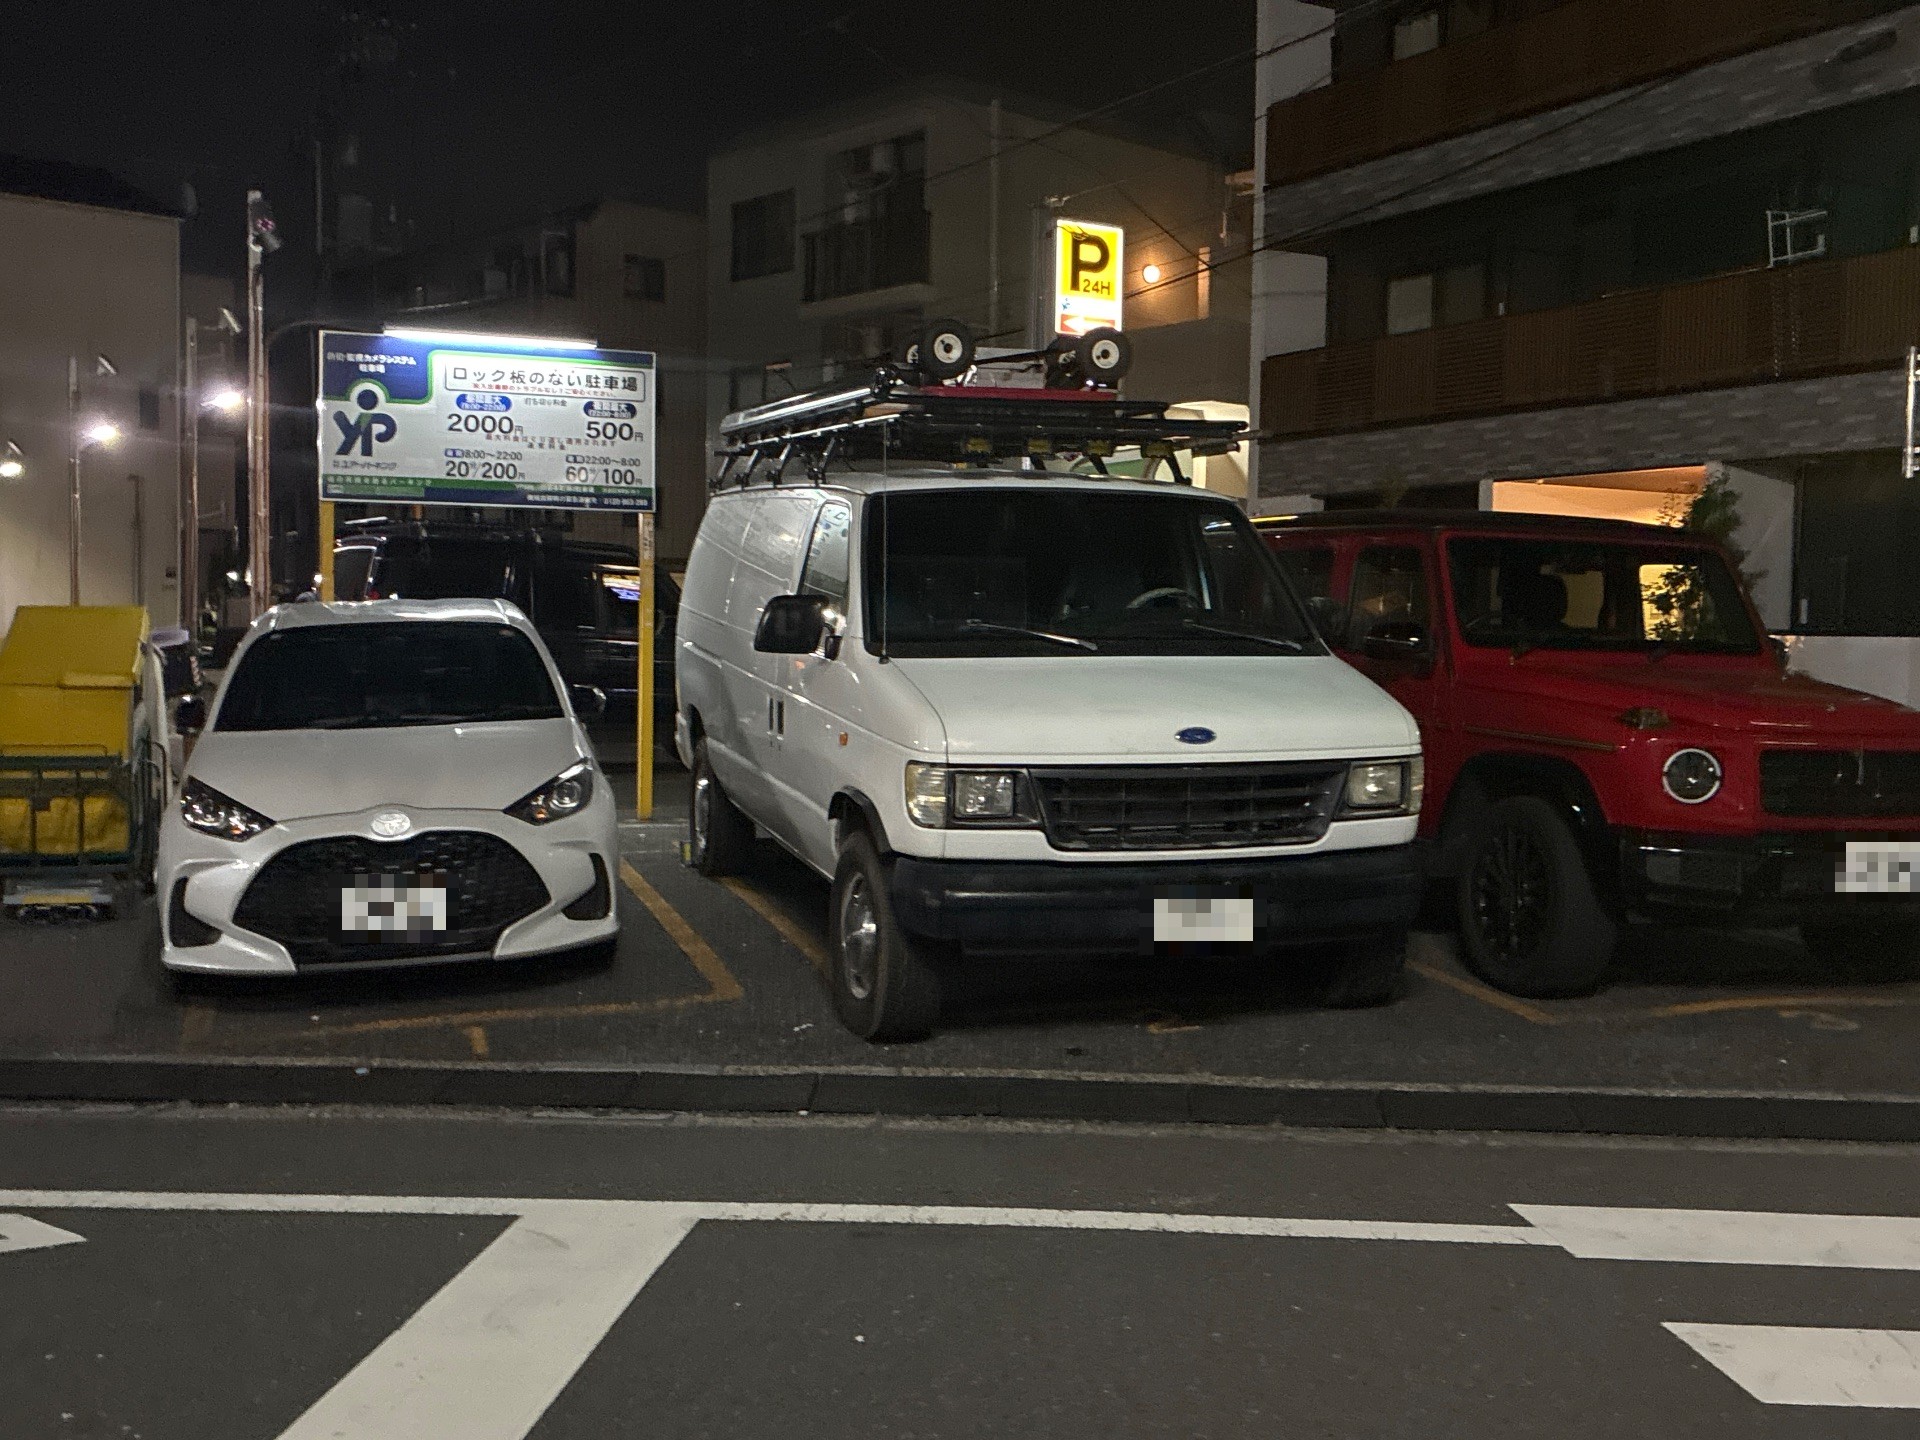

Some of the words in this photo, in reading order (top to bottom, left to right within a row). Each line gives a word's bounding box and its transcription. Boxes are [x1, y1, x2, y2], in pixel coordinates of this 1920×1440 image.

[1070, 231, 1110, 292] P
[1083, 279, 1111, 295] 24H
[453, 368, 638, 392] ロック板のない駐車場
